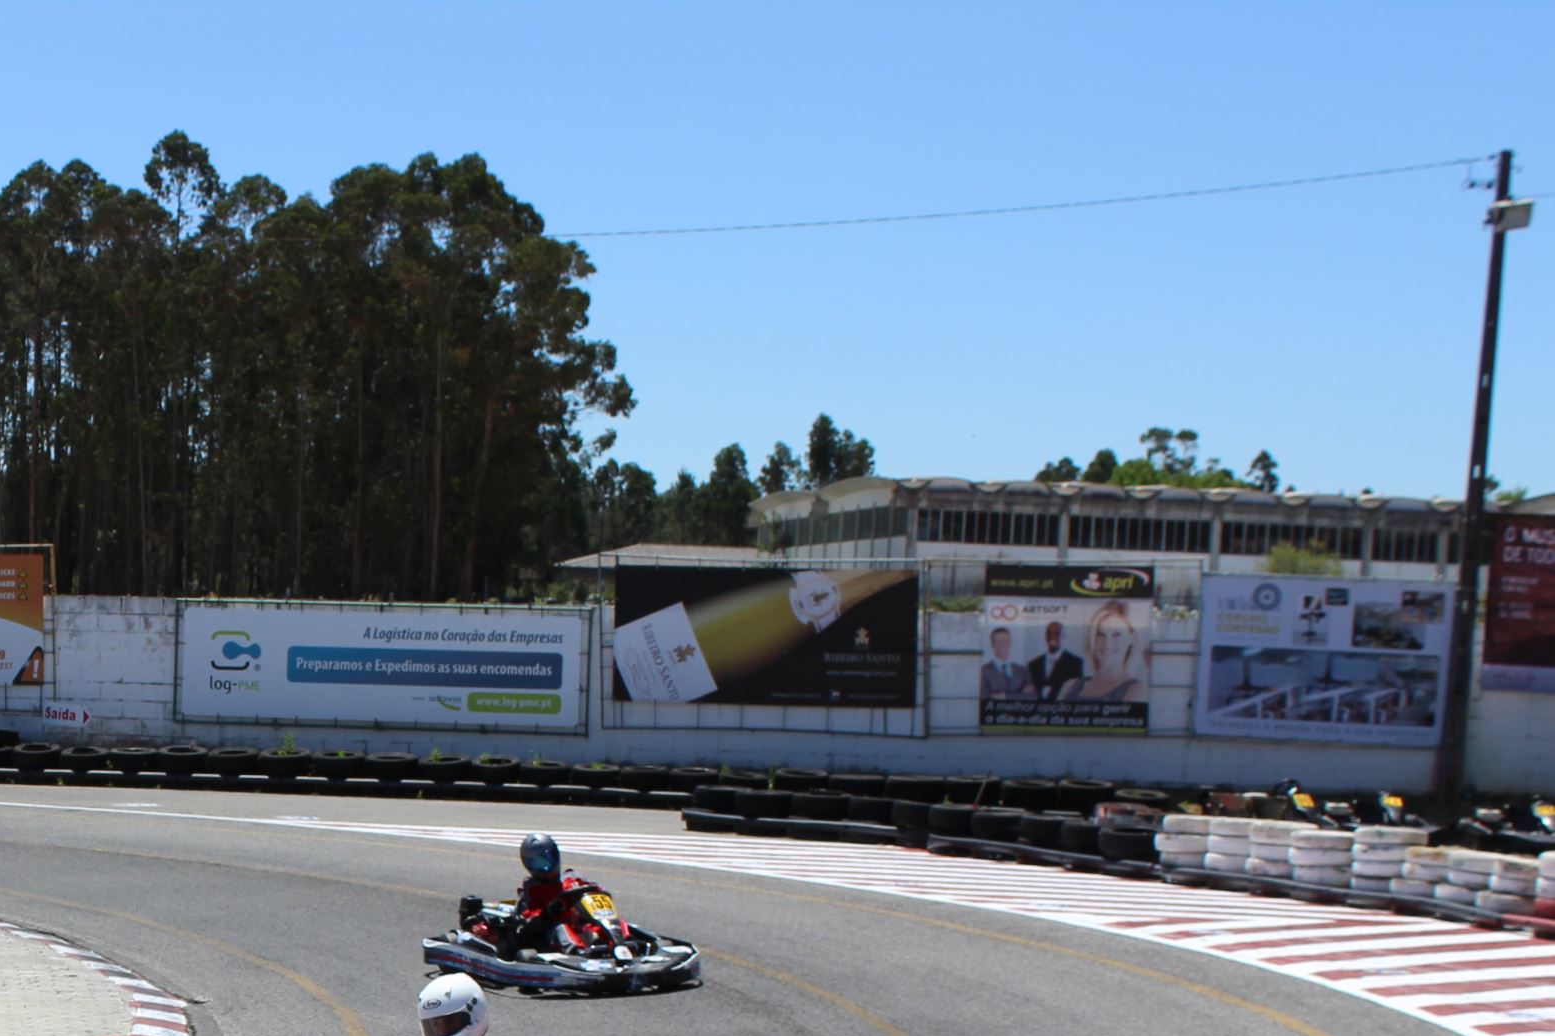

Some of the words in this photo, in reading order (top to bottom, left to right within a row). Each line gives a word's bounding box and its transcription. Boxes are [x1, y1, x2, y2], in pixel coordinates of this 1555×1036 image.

[1103, 576, 1134, 592] apri
[363, 627, 371, 640] A
[373, 627, 422, 643] Logística
[424, 631, 438, 642] no
[441, 628, 485, 645] Coração
[487, 629, 507, 644] das
[509, 630, 564, 646] Empresas
[296, 656, 364, 674] Preparamos
[366, 661, 373, 672] e
[375, 657, 435, 676] Expedimos
[438, 663, 450, 674] as
[452, 663, 477, 675] suas
[480, 661, 553, 677] encomendas
[45, 706, 77, 721] Saída
